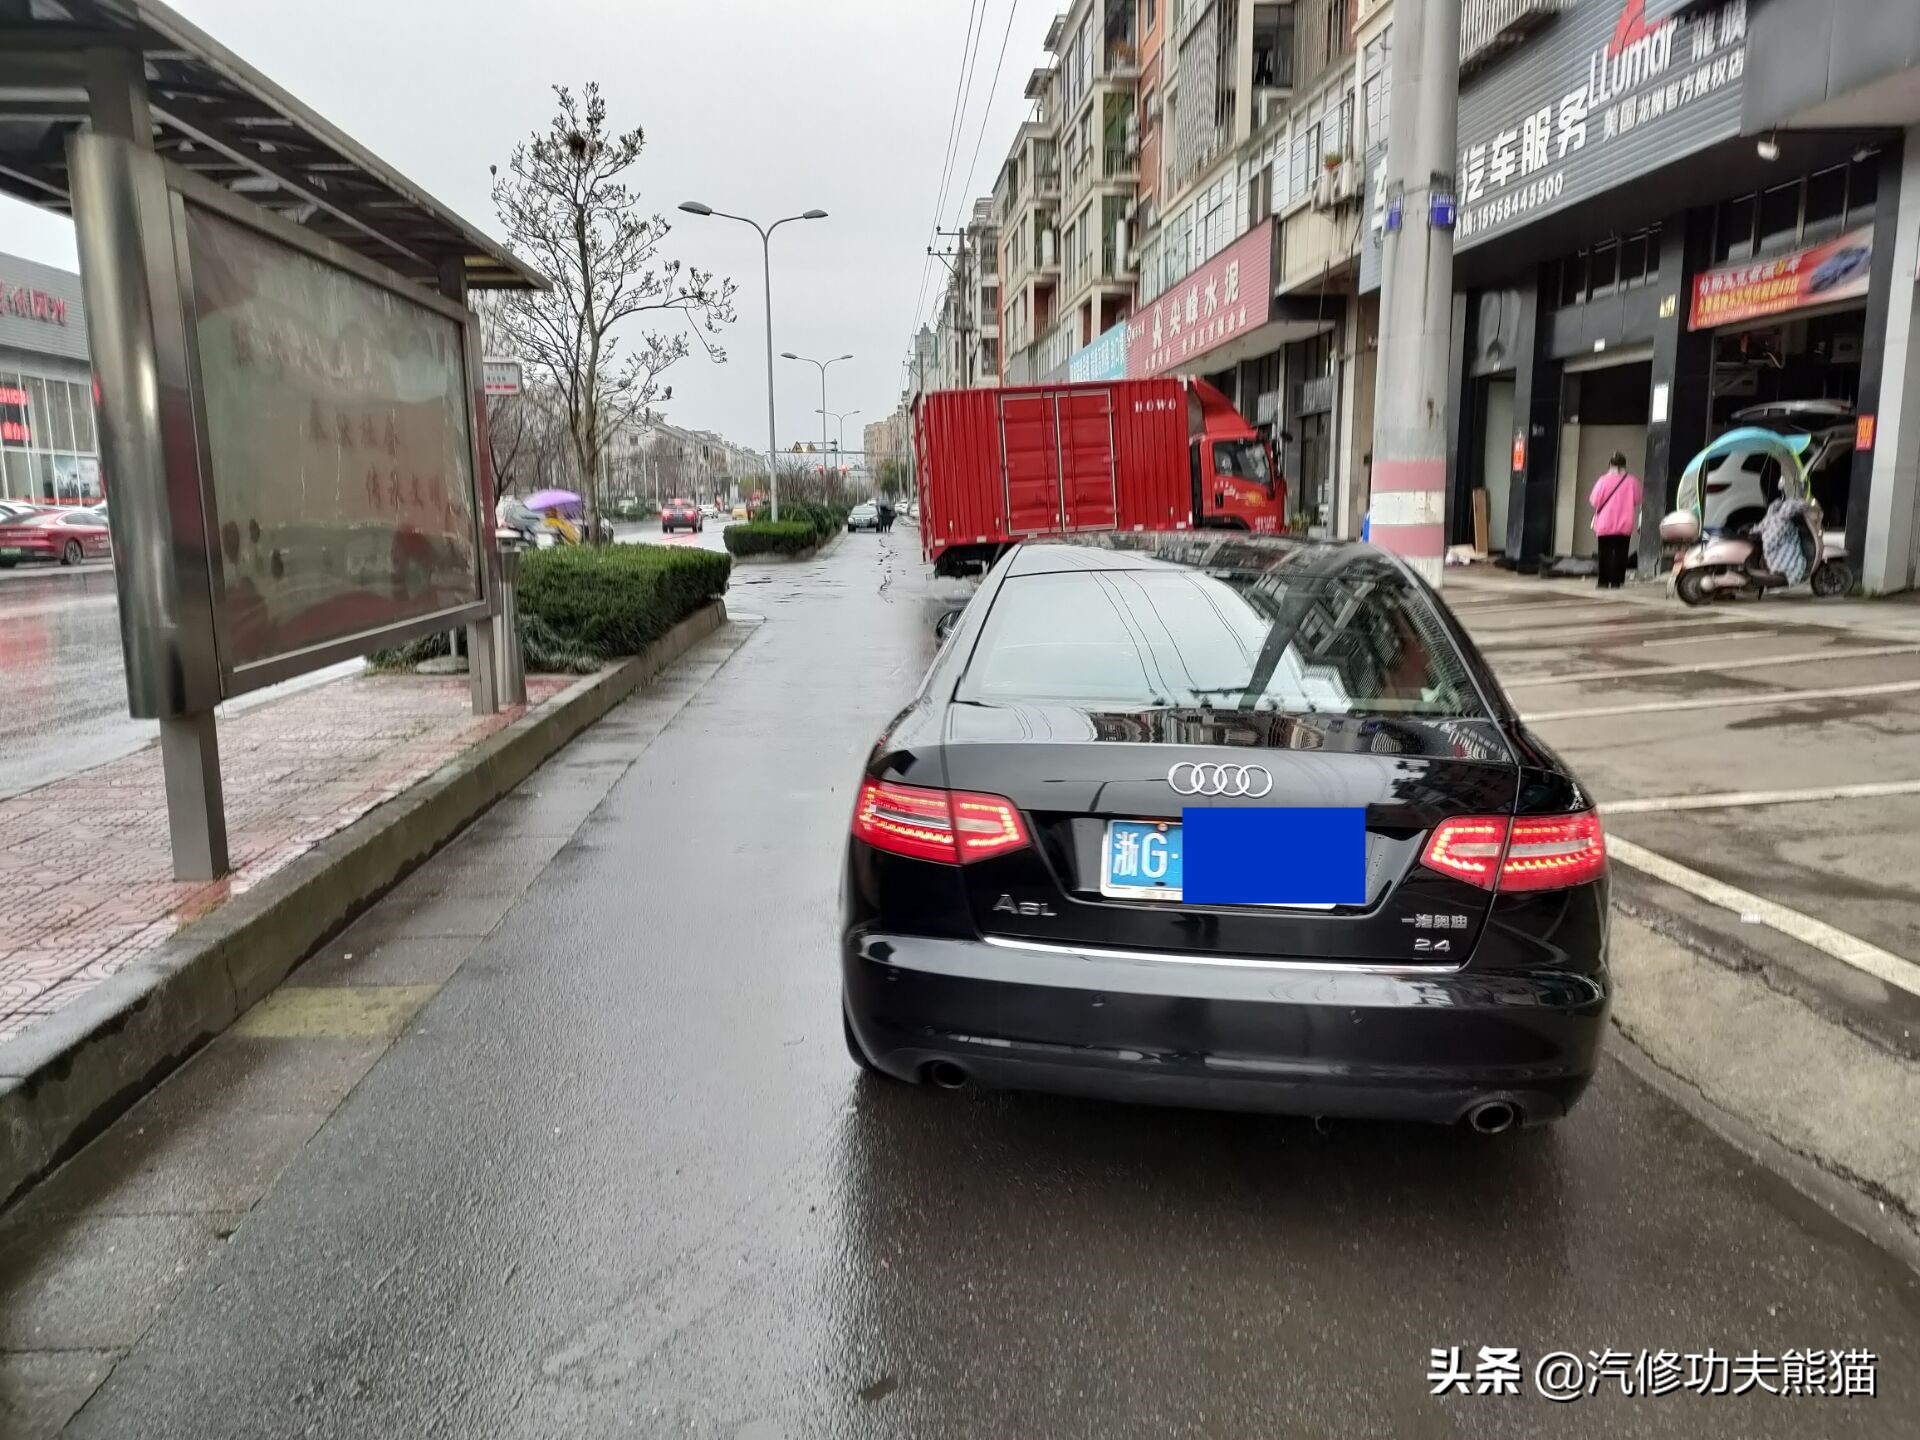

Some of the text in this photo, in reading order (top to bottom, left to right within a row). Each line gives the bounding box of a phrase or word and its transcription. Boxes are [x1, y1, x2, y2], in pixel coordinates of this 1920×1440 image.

[1589, 17, 1678, 110] LLumar
[1461, 85, 1588, 207] 汽车服务
[1401, 913, 1468, 929] 一汽奥迪
[1414, 938, 1451, 953] 2.4
